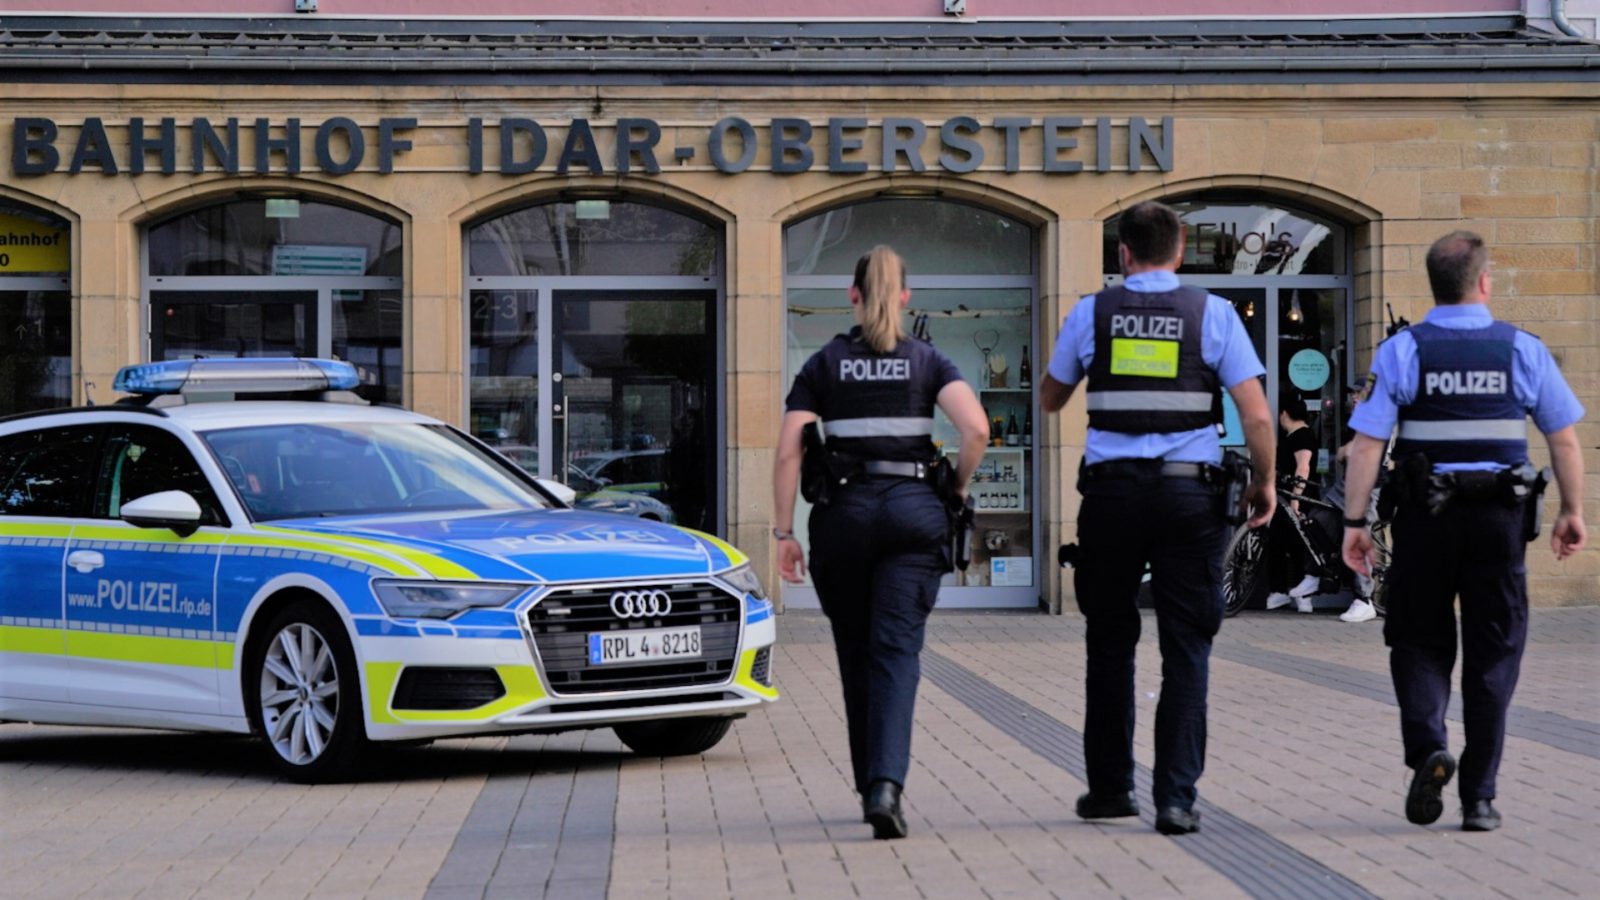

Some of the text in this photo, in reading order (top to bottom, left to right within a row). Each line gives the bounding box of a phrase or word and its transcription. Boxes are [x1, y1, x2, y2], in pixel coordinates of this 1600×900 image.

[12, 115, 1175, 175] BAHNHOF IDAR-OBERSTEIN
[1196, 222, 1294, 256] Ella's
[474, 294, 518, 319] 2-3
[1110, 314, 1184, 340] POLIZEI
[840, 358, 911, 381] POLIZEI
[1426, 371, 1507, 395] POLIZEI
[492, 531, 669, 550] POLIZEI
[68, 578, 212, 618] www.POLIZEI.rlp.de
[603, 637, 635, 660] RPL
[641, 636, 649, 657] 4
[663, 631, 700, 655] 8218
